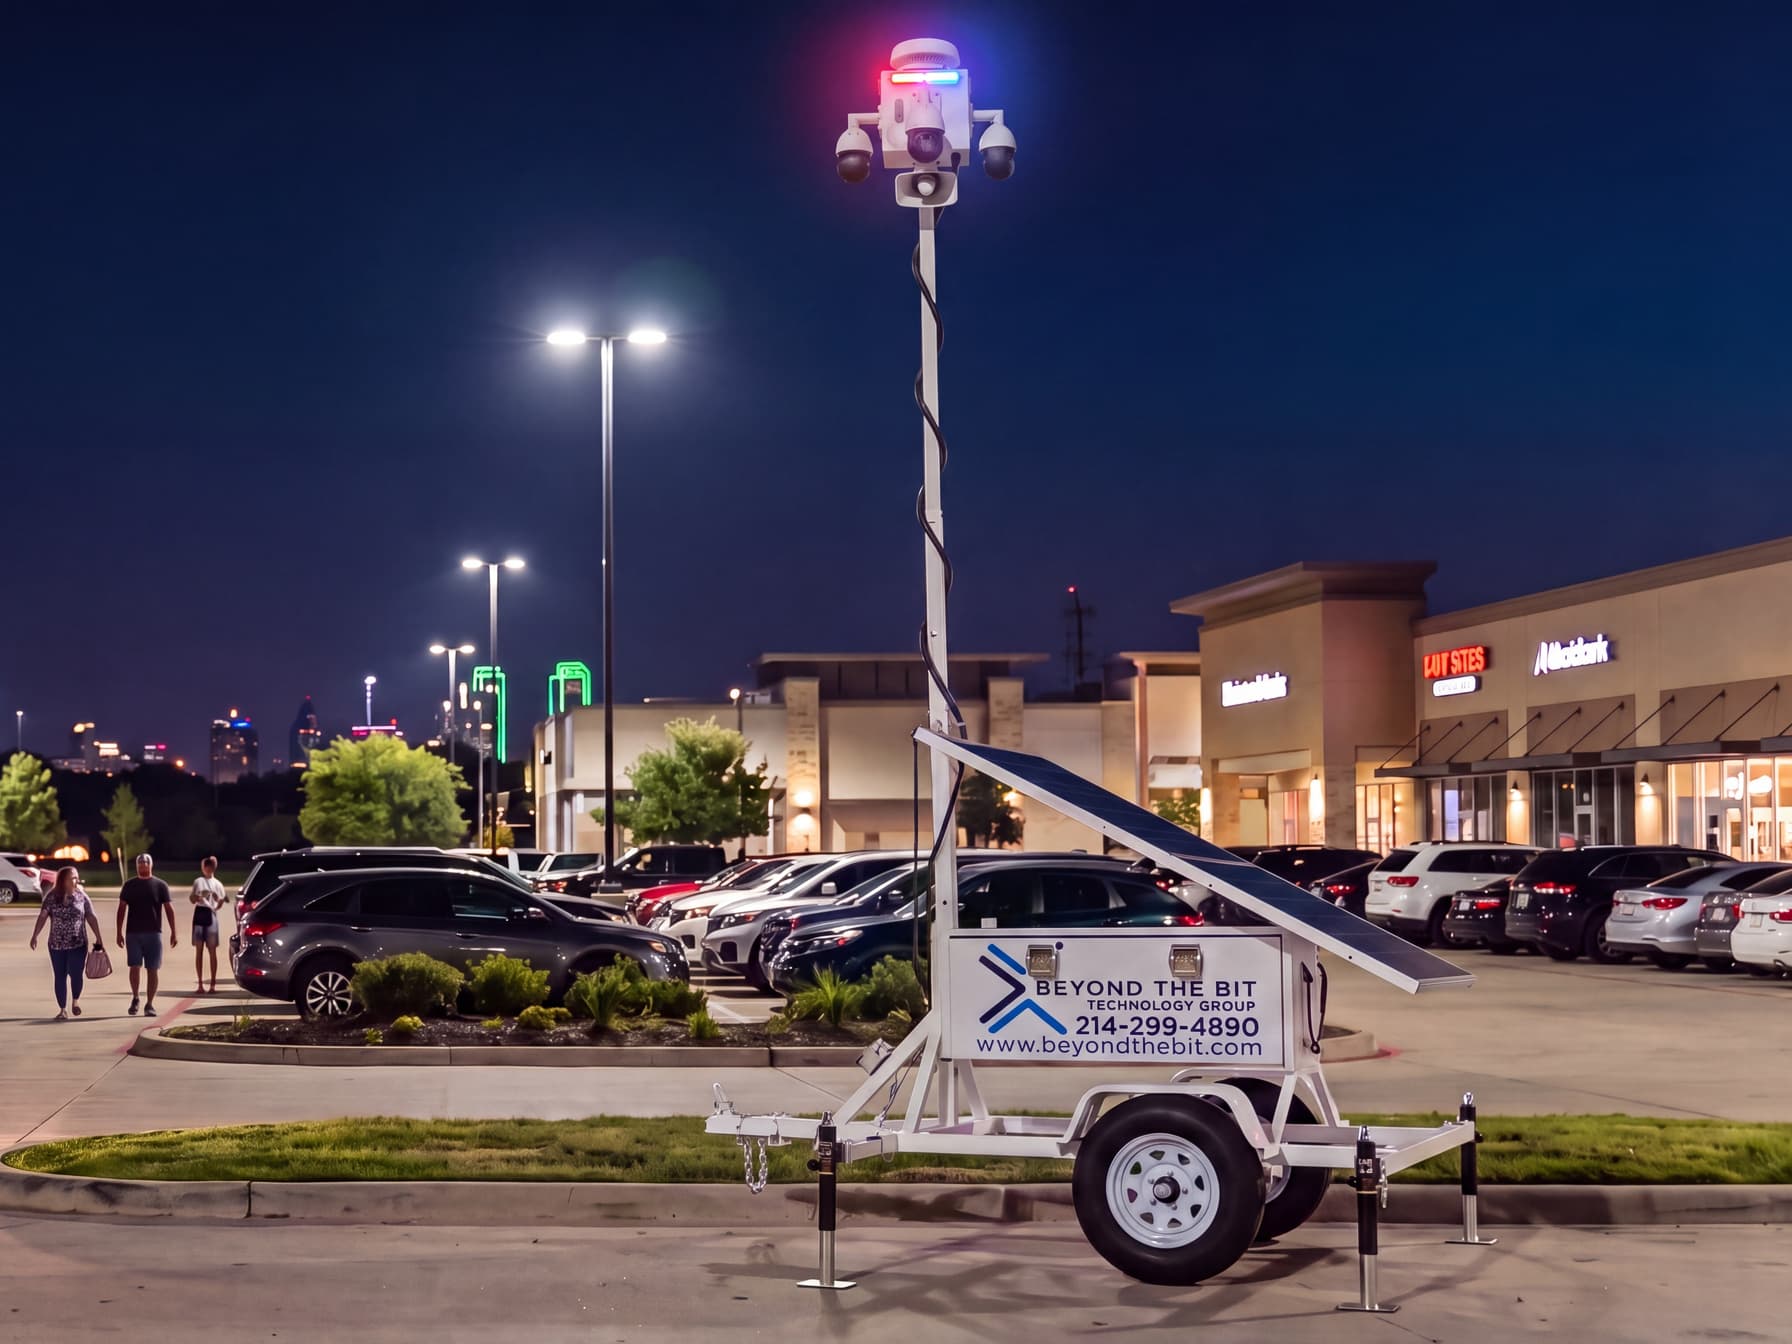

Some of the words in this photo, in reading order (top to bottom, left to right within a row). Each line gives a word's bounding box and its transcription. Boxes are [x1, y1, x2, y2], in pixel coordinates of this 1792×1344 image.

[1037, 980, 1142, 996] BEYOND
[1154, 981, 1203, 996] THE
[1216, 981, 1256, 996] BIT
[1087, 1000, 1193, 1011] TECHNOLOGY
[1200, 1001, 1255, 1011] GROUP
[1076, 1016, 1258, 1036] 214-299-4890
[977, 1036, 1261, 1057] www.beyondthebit.com
